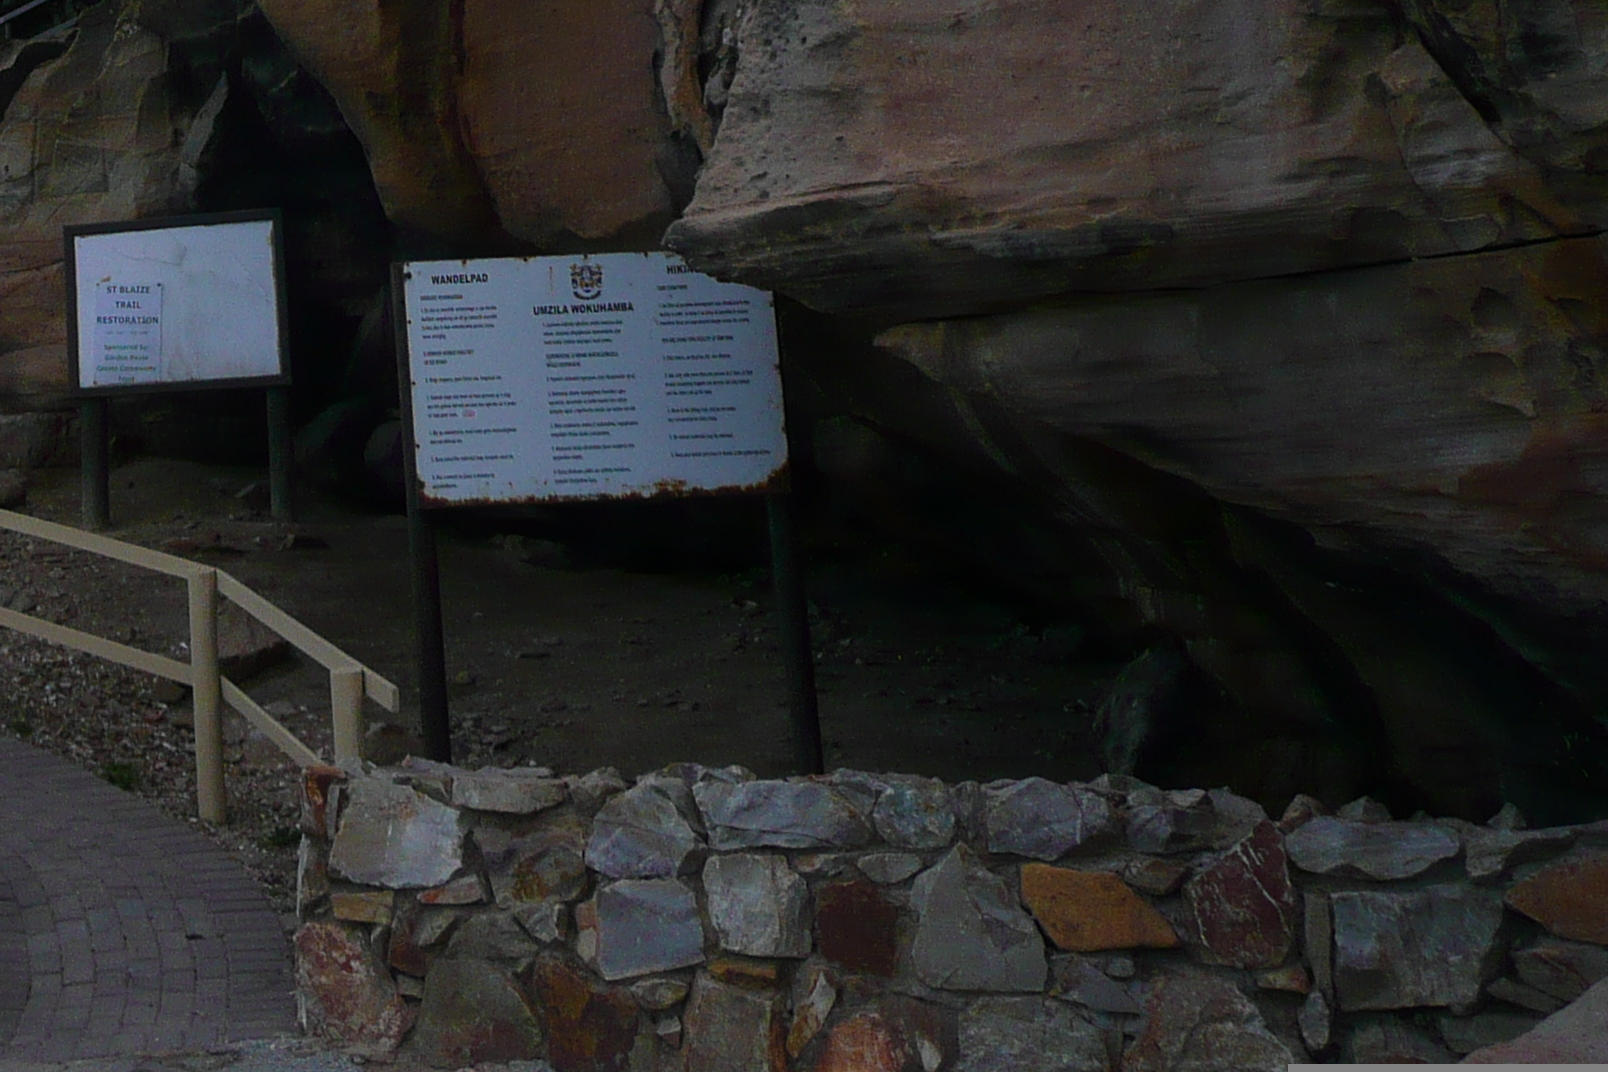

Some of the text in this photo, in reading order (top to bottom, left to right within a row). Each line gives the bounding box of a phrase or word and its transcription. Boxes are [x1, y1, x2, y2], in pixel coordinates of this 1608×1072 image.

[431, 273, 489, 285] WANDELPAD
[106, 285, 151, 294] ST BLAIZE
[115, 300, 142, 309] TRAIL
[533, 302, 634, 316] UMZILA WOKUHAMBA
[96, 315, 159, 324] RESTORATION
